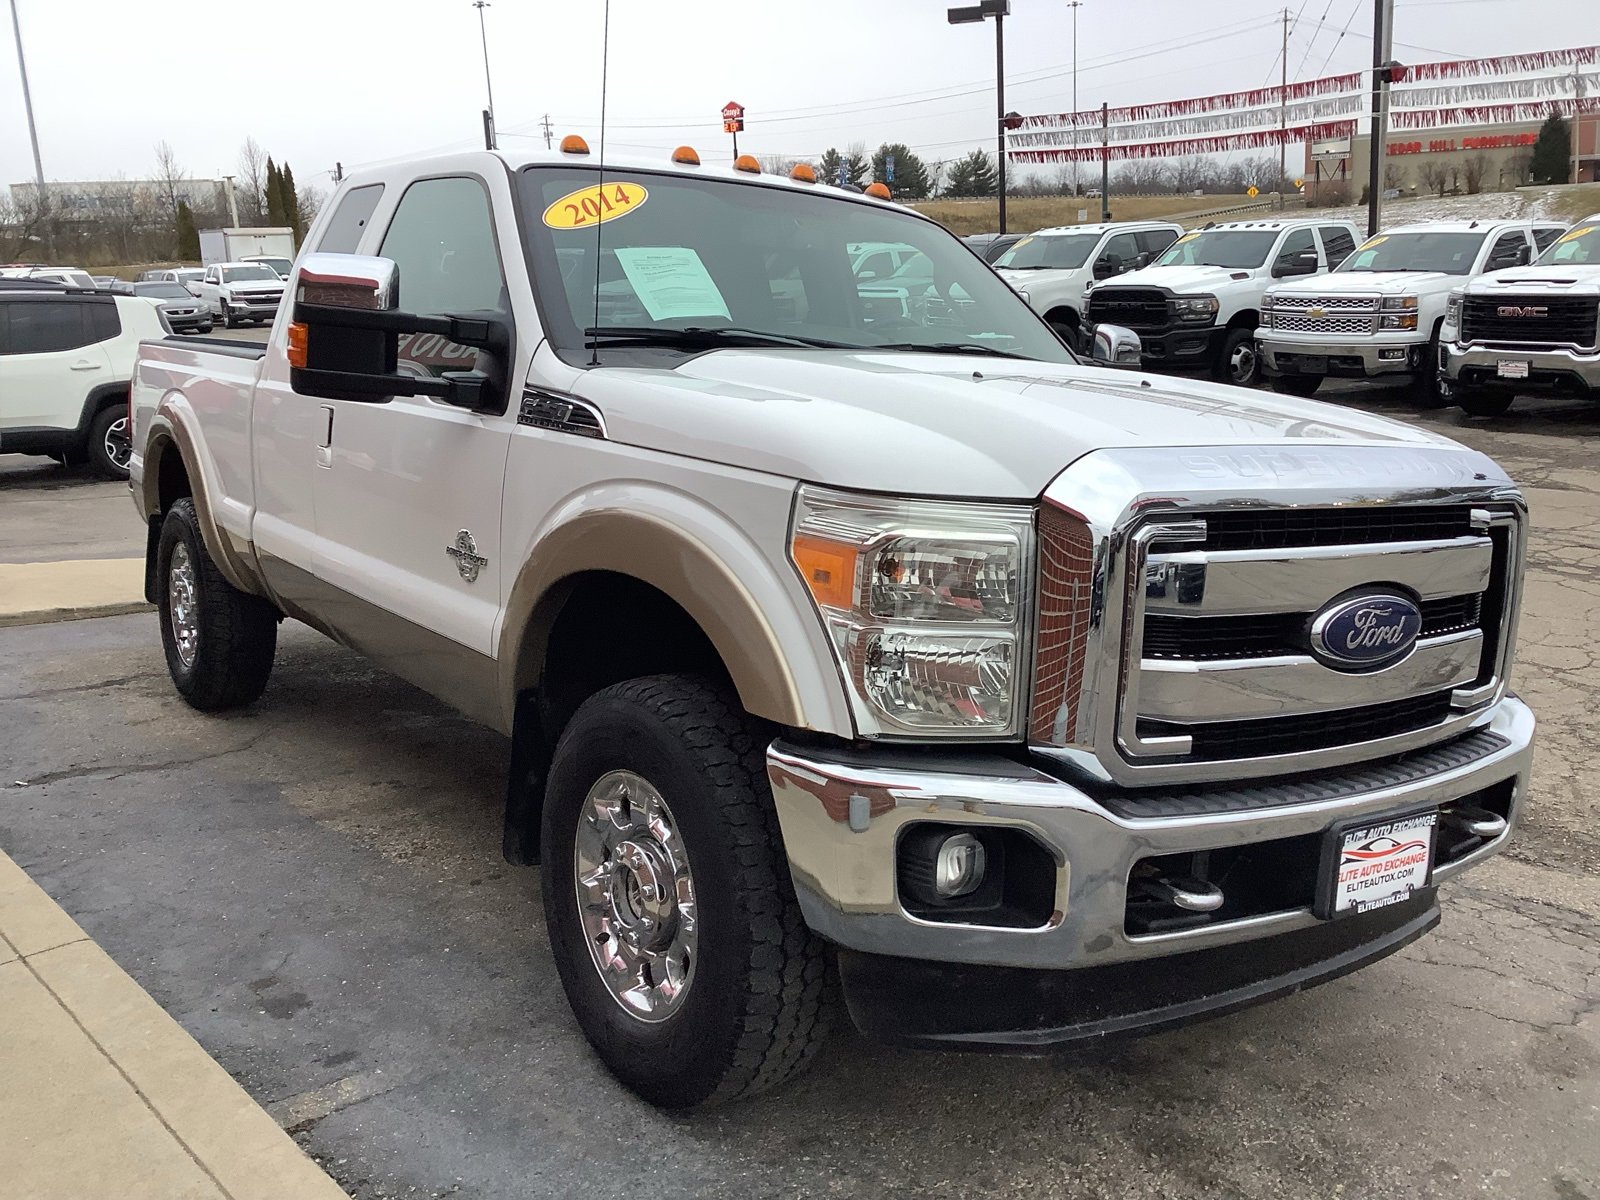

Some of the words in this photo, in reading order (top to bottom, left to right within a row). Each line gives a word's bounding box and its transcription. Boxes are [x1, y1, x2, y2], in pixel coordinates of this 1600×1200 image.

[1429, 139, 1457, 152] HILL
[1462, 133, 1537, 150] FURNITURE
[564, 184, 631, 225] 2014
[1497, 306, 1549, 317] GMC
[1178, 453, 1368, 479] SUPER
[1346, 608, 1406, 649] Ford
[1345, 829, 1367, 844] ELITE
[1368, 824, 1391, 840] AUTO
[1391, 814, 1437, 835] EXCHANGE
[1360, 863, 1383, 877] AUTO
[1383, 852, 1426, 872] EXCHANGE
[1346, 867, 1415, 893] ELITEAUTOX.COM
[1357, 891, 1410, 914] ELITEAUTOX.COM
